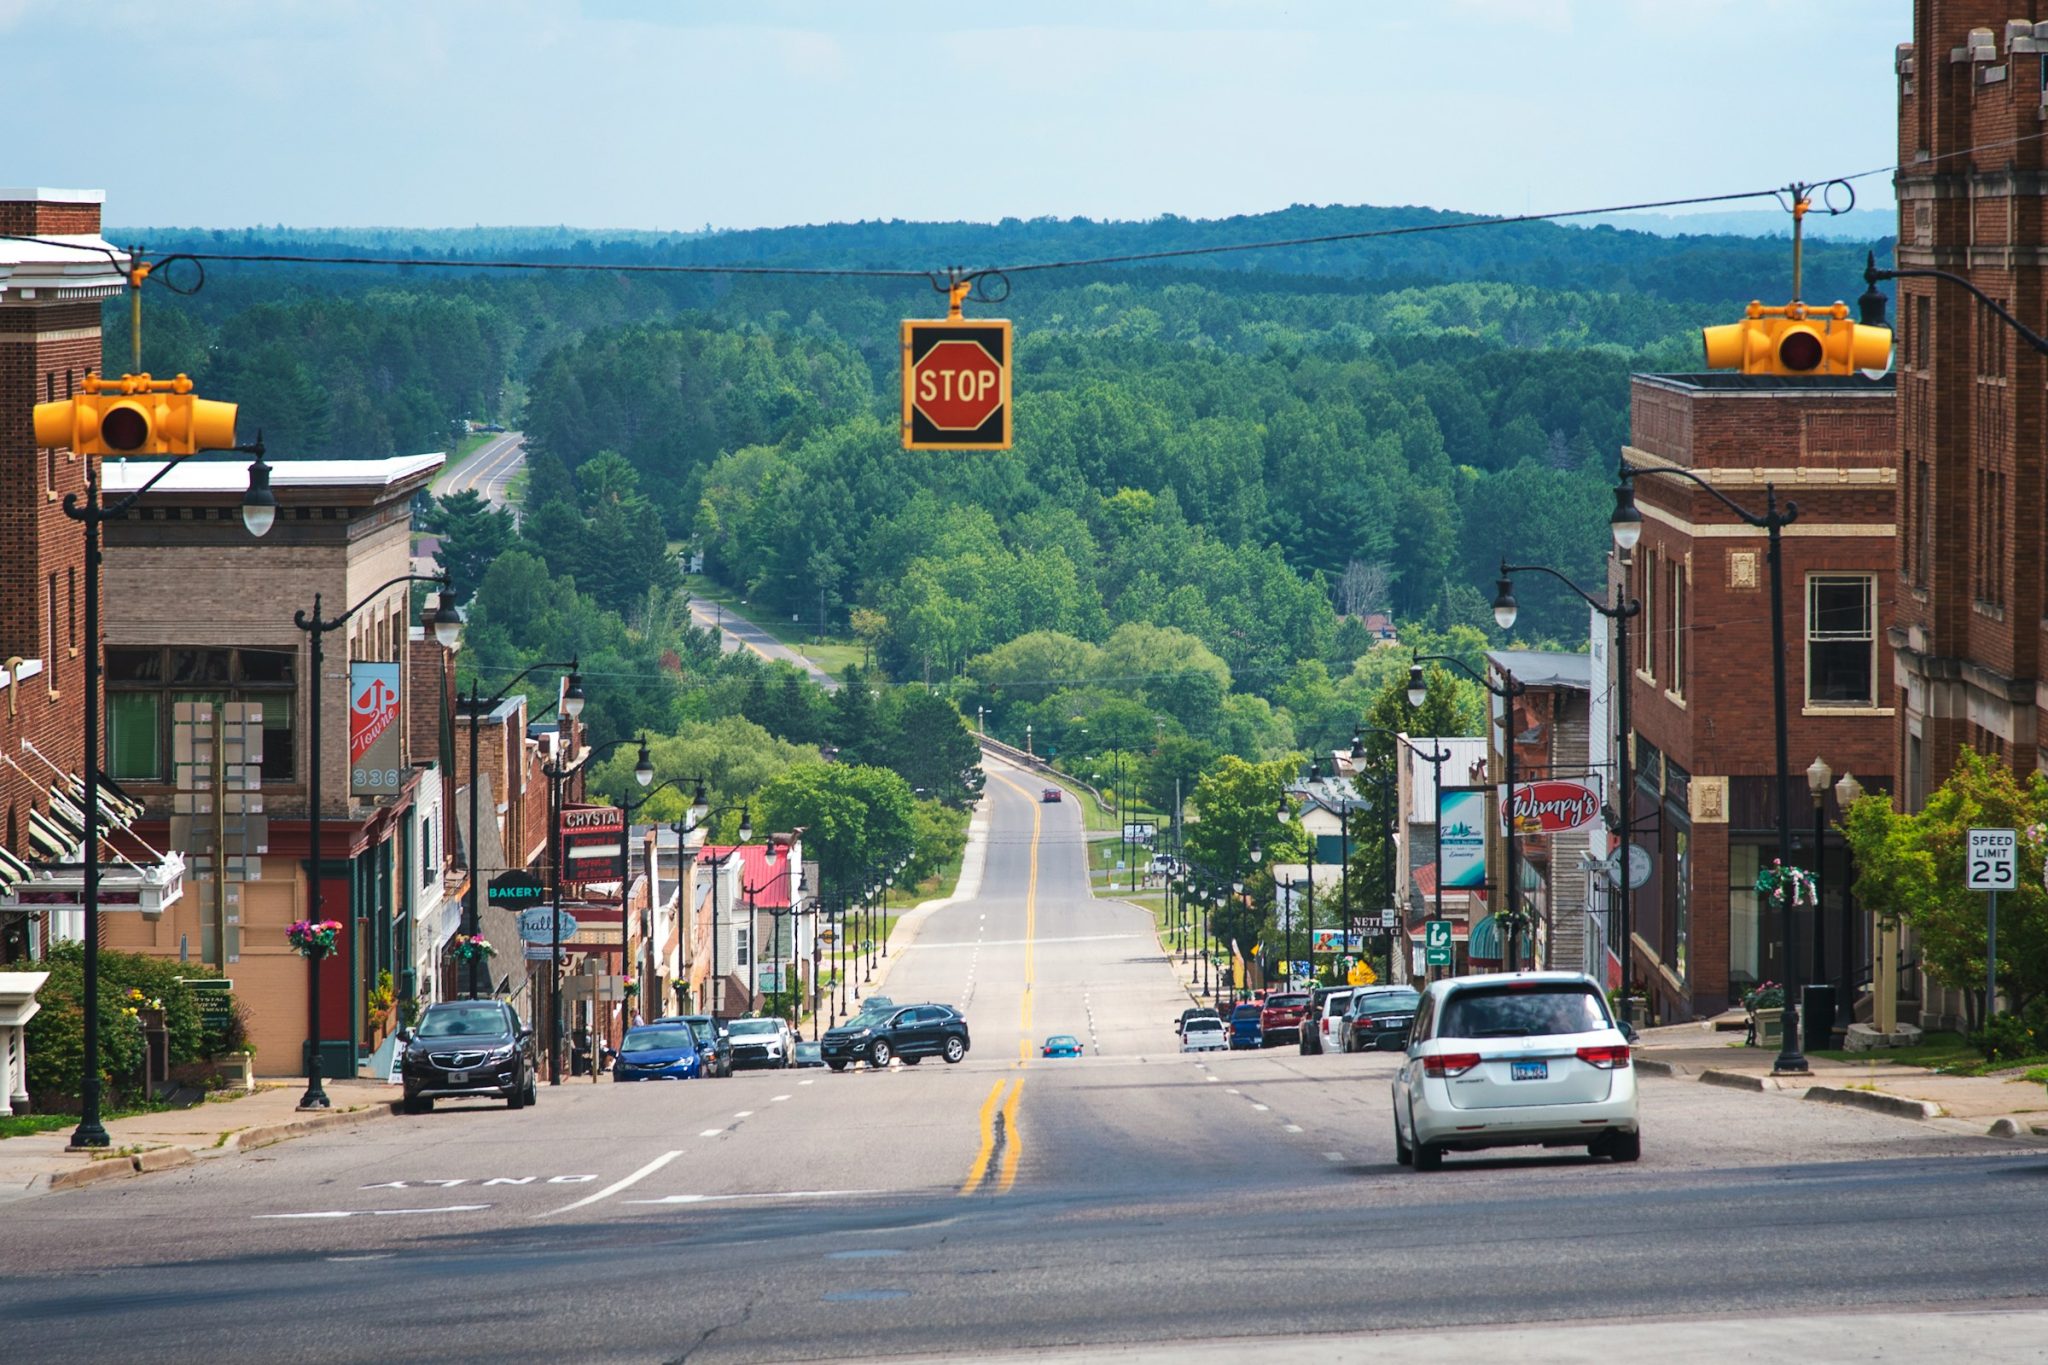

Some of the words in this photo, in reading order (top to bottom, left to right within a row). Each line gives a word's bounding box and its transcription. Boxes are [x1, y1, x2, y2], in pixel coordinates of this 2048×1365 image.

[920, 369, 996, 402] STOP
[351, 684, 400, 715] UP
[351, 708, 396, 750] Towne
[353, 769, 399, 787] 336
[1505, 784, 1595, 828] Wimpy's
[1972, 836, 2013, 846] SPEED
[1976, 849, 2008, 858] LIMIT
[1972, 861, 2012, 883] 25
[489, 887, 542, 898] BAKERY
[358, 1174, 599, 1190] ONLY
